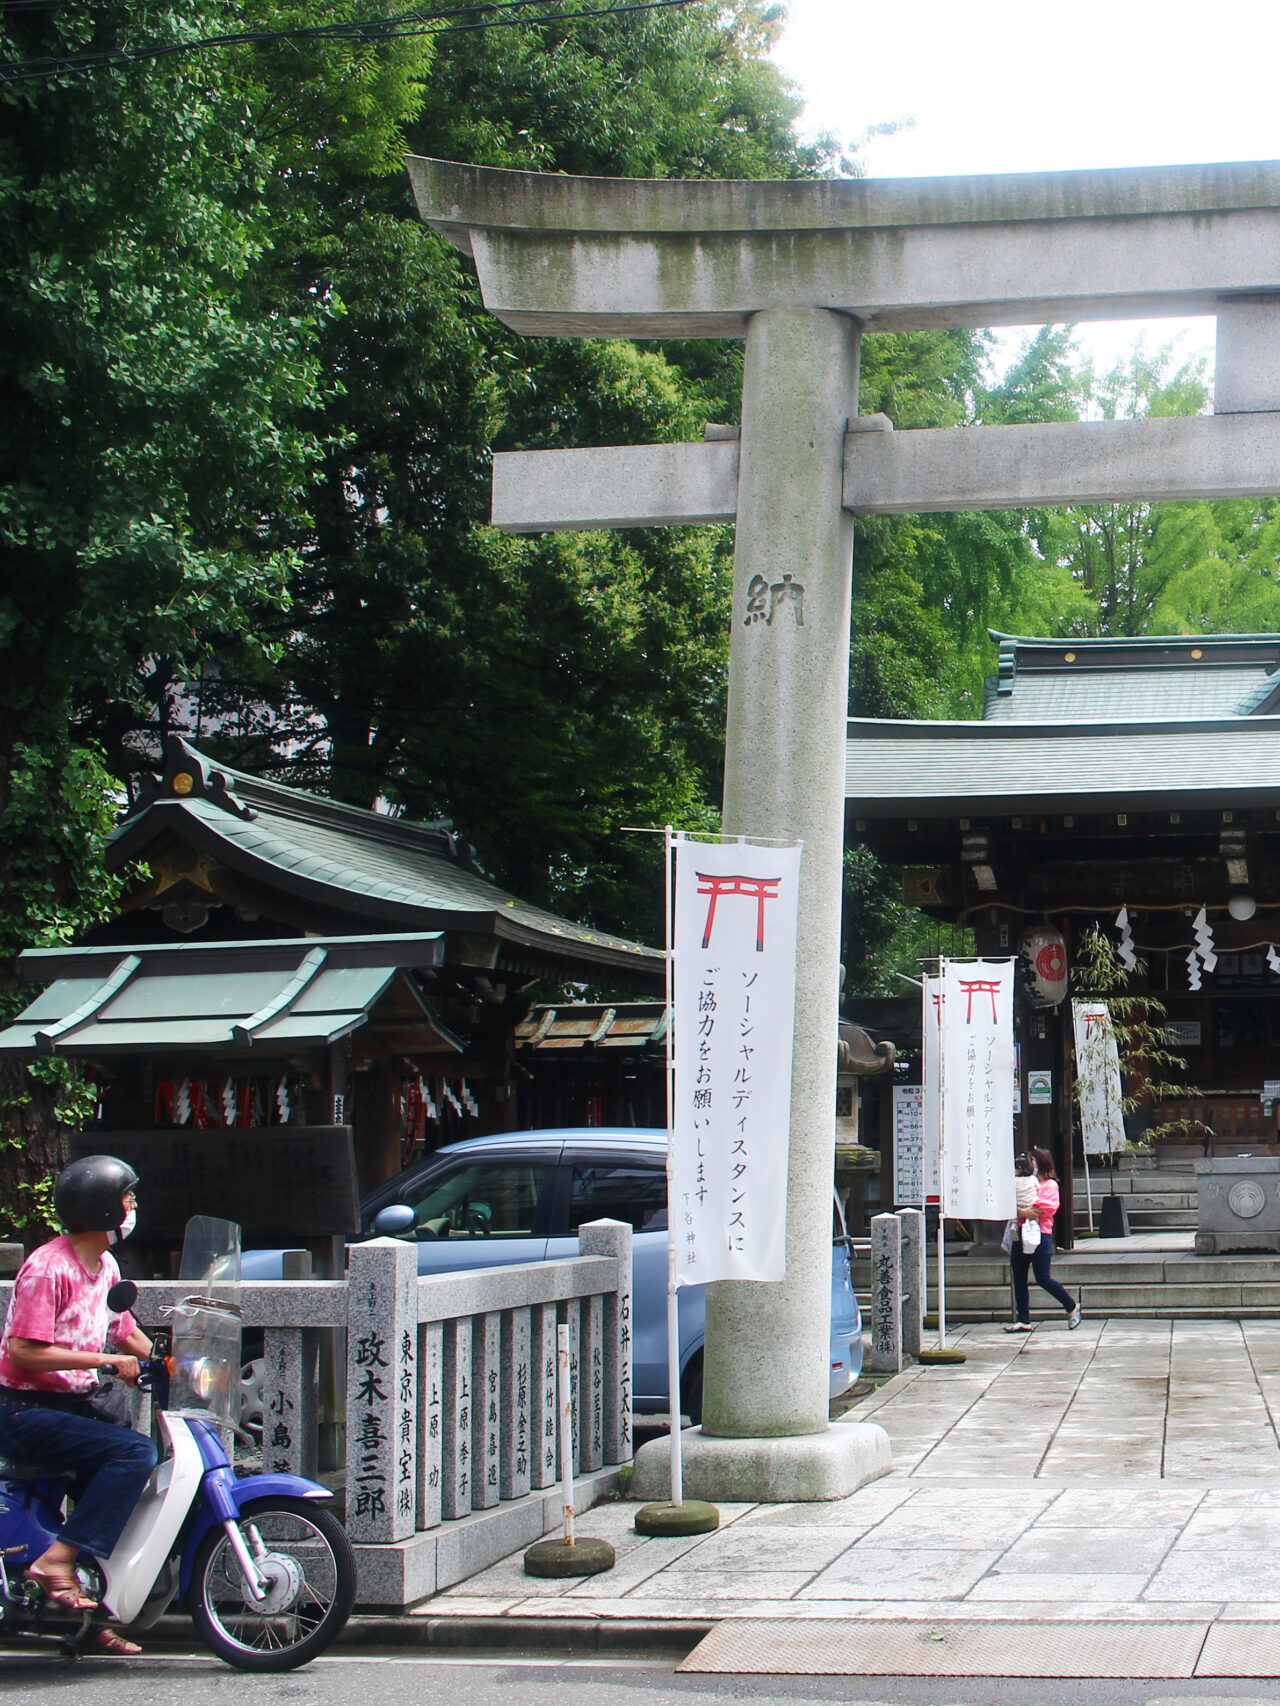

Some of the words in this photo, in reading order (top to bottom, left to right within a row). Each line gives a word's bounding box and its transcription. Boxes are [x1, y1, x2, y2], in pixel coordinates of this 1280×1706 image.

[744, 574, 805, 626] 納
[694, 967, 721, 1208] ご協力をお願いします
[727, 970, 759, 1252] ソーシャルディスタンスに
[965, 1034, 977, 1175] ご協力をお願いします
[983, 1035, 996, 1203] ソーシャルディスタンスに
[682, 1192, 697, 1264] 下谷神社
[355, 1330, 389, 1521] 政木喜三郎
